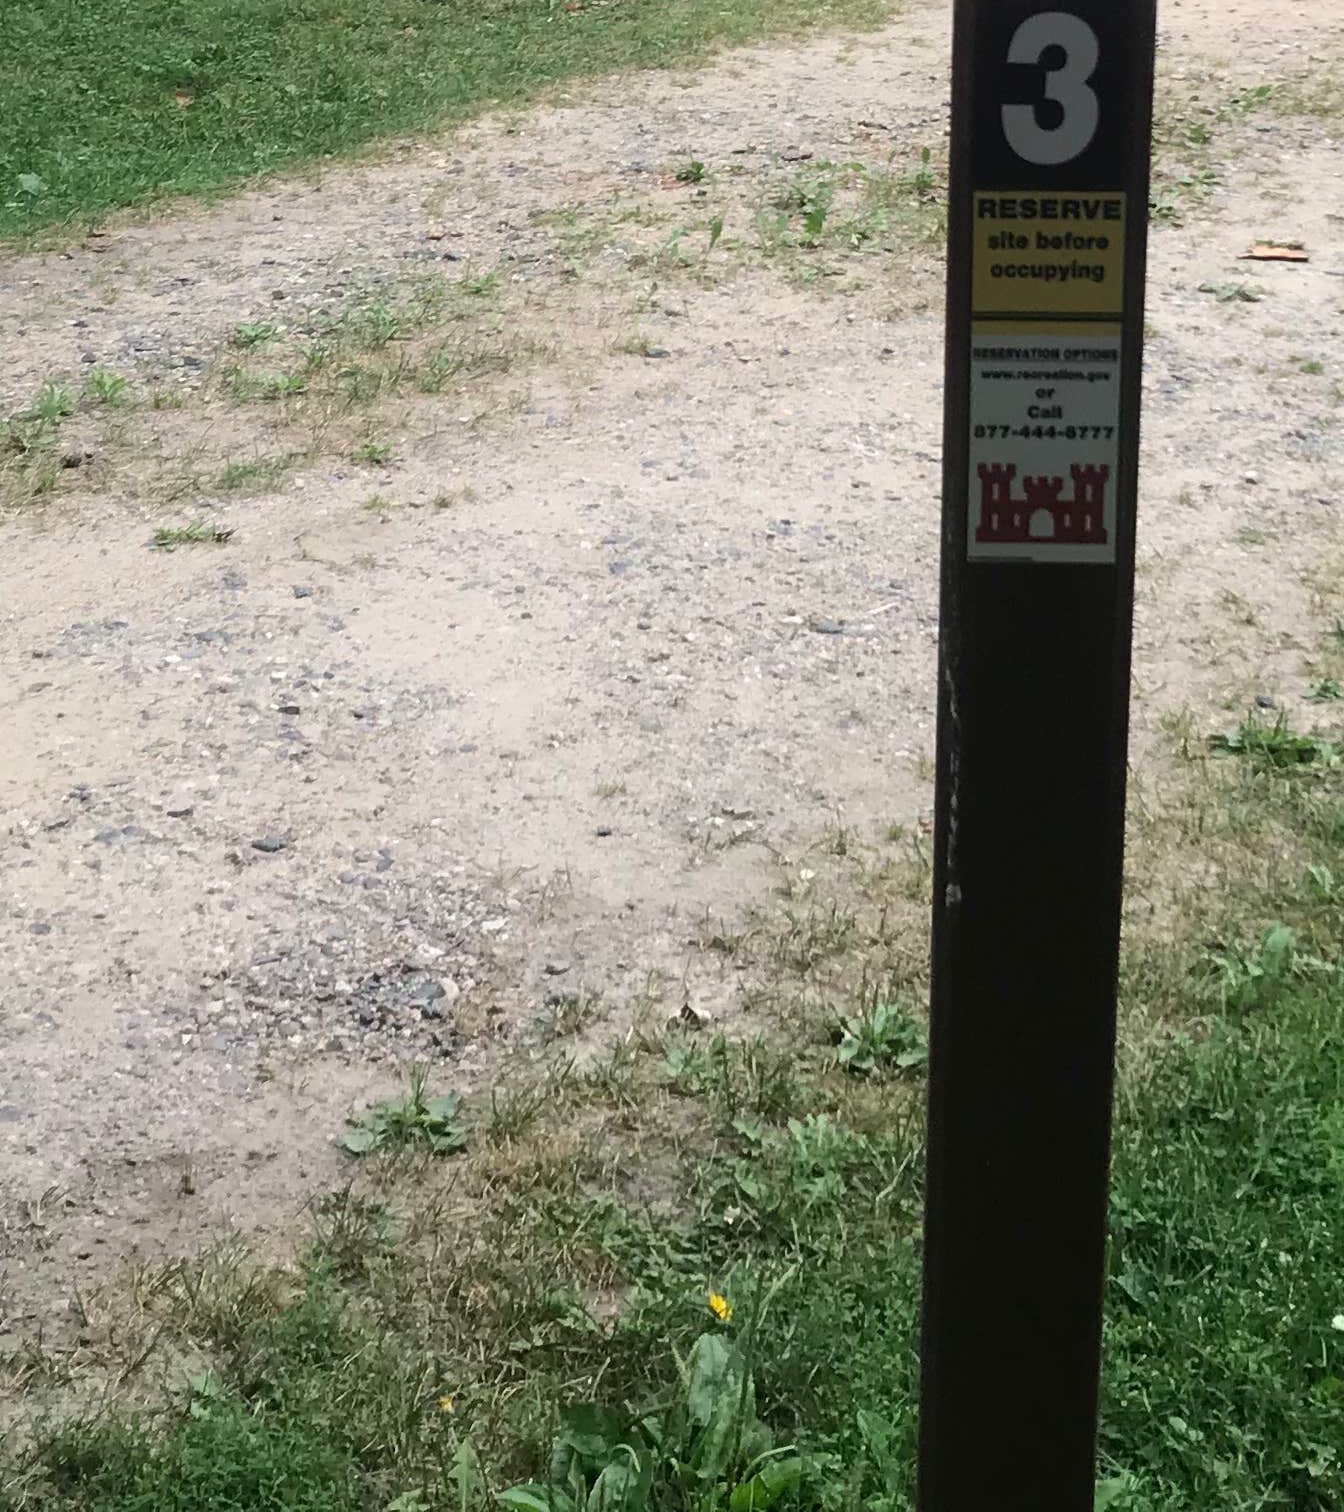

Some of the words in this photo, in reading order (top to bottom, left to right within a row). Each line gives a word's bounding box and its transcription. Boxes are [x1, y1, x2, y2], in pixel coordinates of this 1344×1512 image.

[1000, 11, 1099, 165] 3
[977, 198, 1122, 220] RESERVE
[988, 231, 1029, 250] site
[1036, 231, 1109, 250] before
[990, 259, 1105, 282] occupying
[973, 347, 1060, 361] RESERVATION
[1035, 388, 1055, 399] or
[1027, 405, 1062, 419] Call
